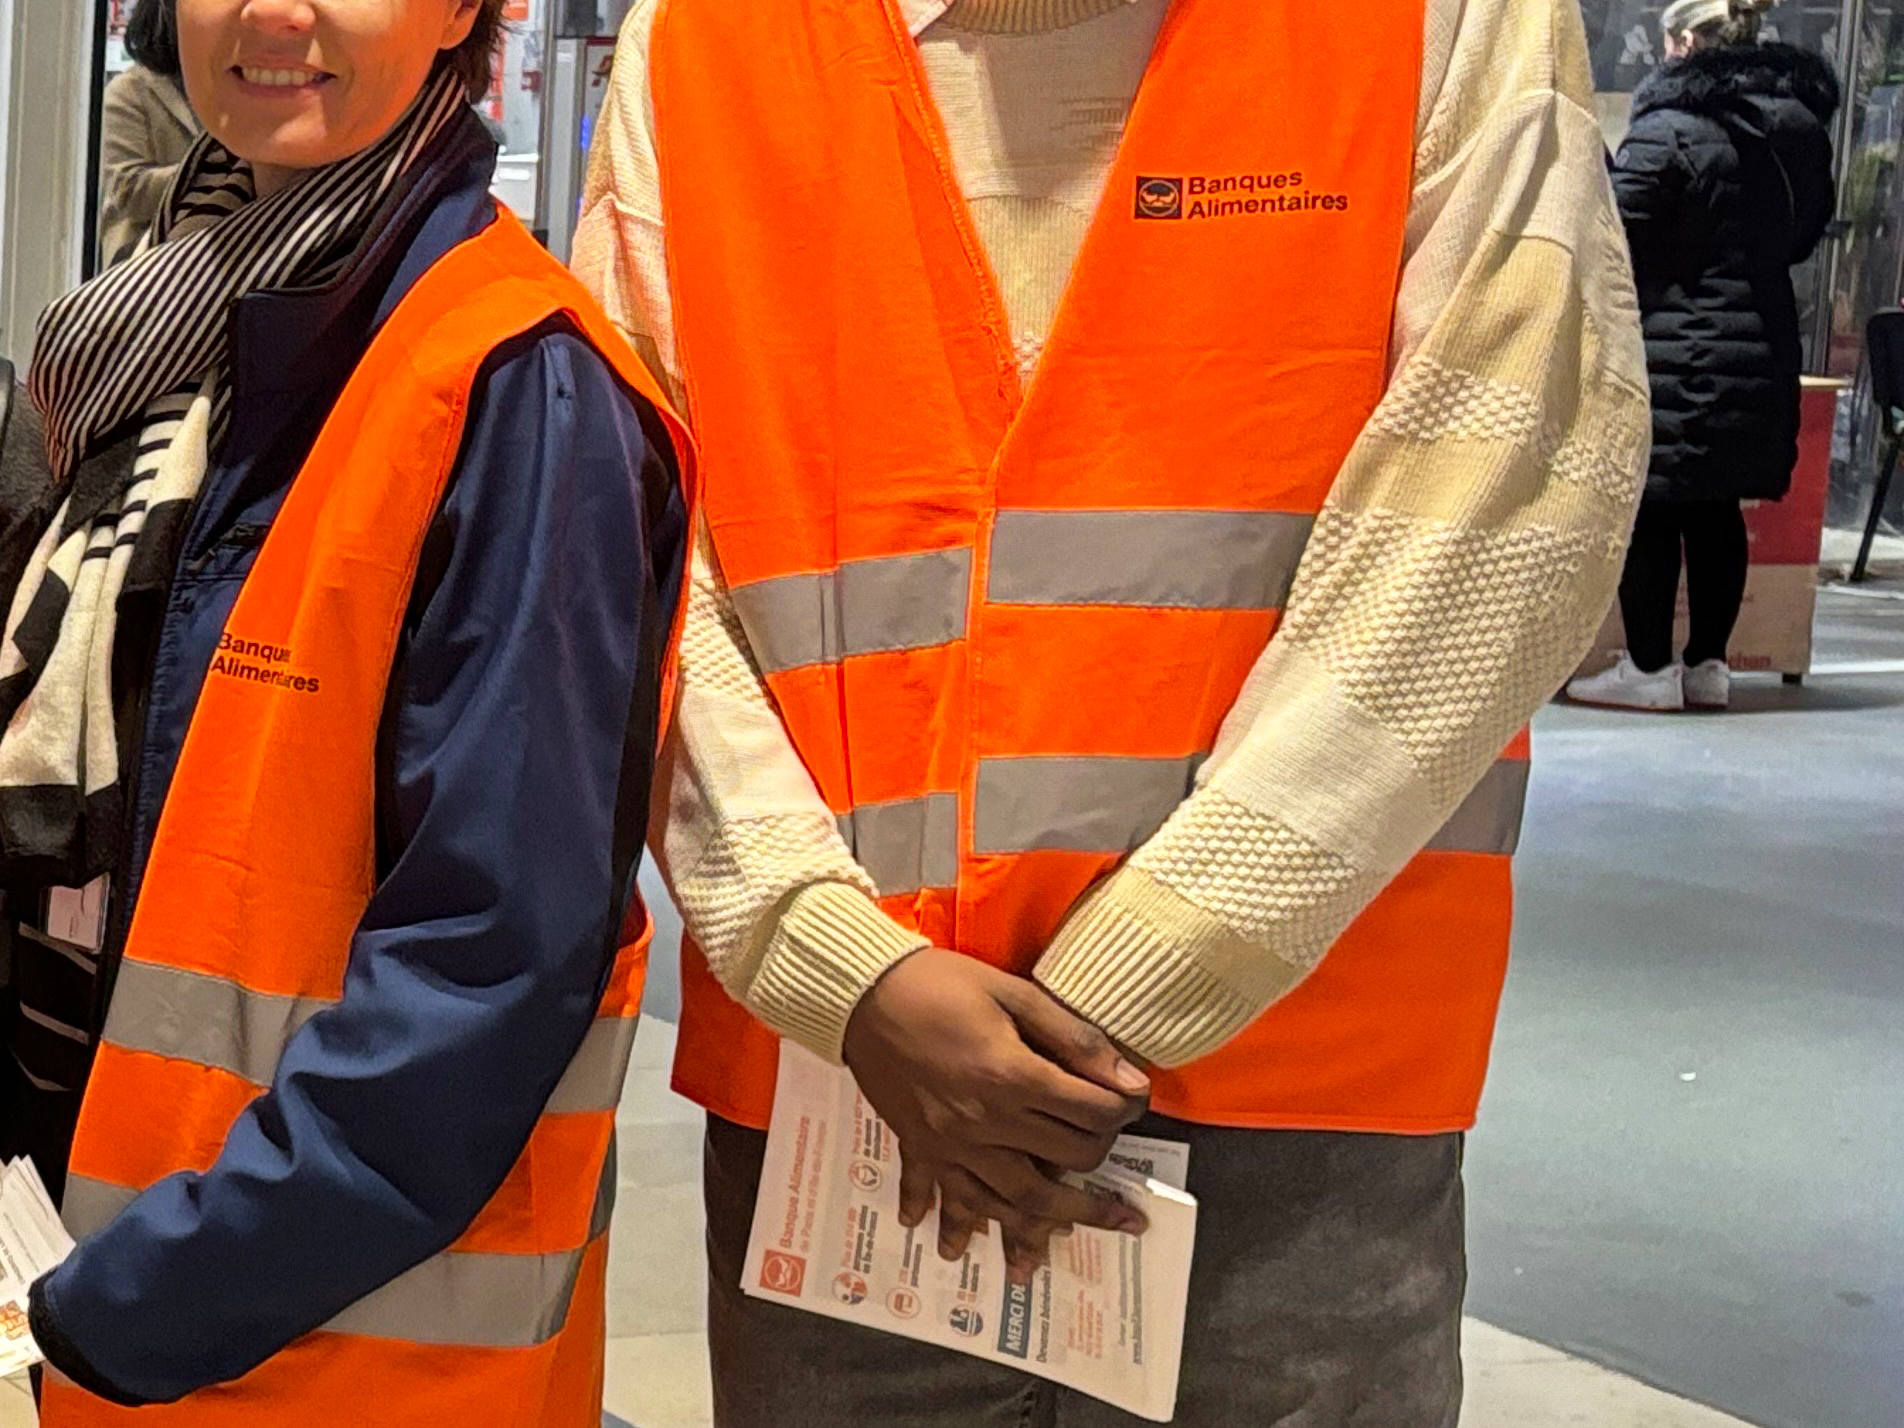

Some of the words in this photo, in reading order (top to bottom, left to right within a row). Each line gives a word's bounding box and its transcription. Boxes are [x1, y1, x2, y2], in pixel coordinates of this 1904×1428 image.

[1187, 189, 1349, 220] Alimentaires
[1188, 171, 1304, 194] Banques
[788, 1115, 810, 1195] Alimentaire
[779, 1196, 799, 1249] Banque
[1040, 1270, 1050, 1320] bénévoles
[1006, 1303, 1025, 1351] MERCI
[1036, 1320, 1049, 1363] Devenez
